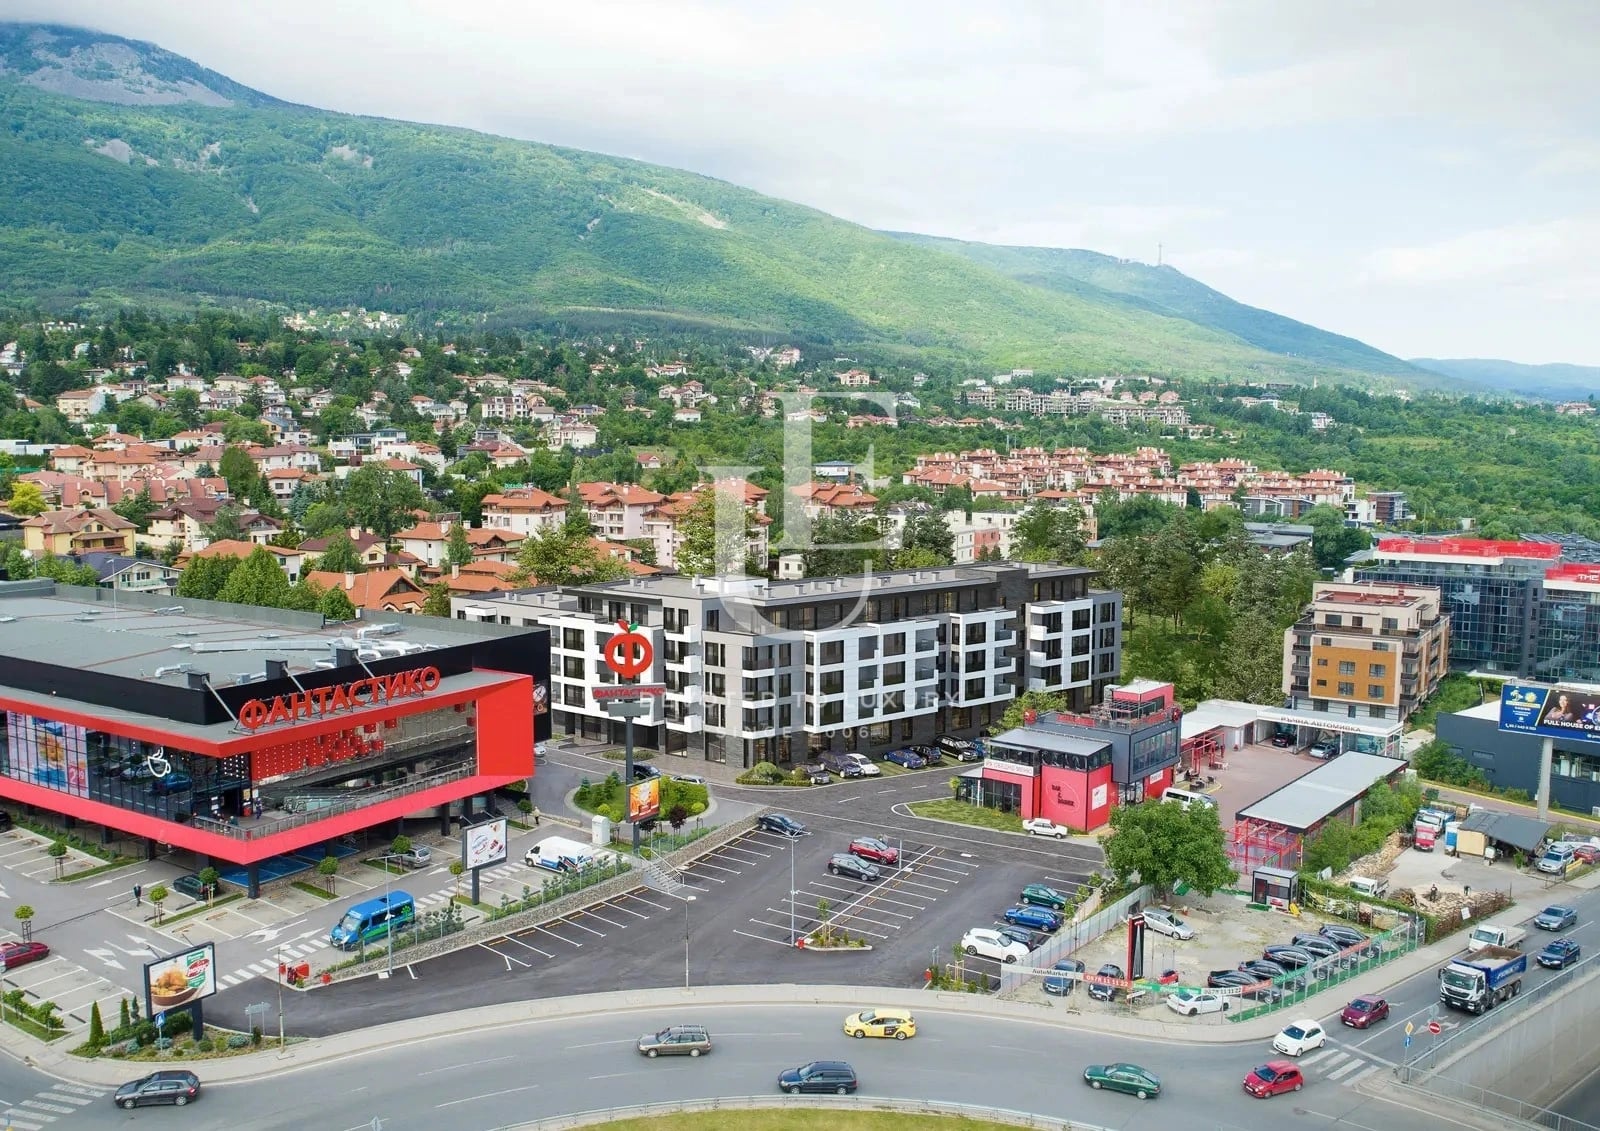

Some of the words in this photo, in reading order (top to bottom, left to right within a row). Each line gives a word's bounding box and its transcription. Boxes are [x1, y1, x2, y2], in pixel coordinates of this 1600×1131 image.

[239, 665, 441, 729] ФАНТАСТИКО
[1561, 721, 1584, 729] HOUSE
[1032, 968, 1068, 977] AutoMarket
